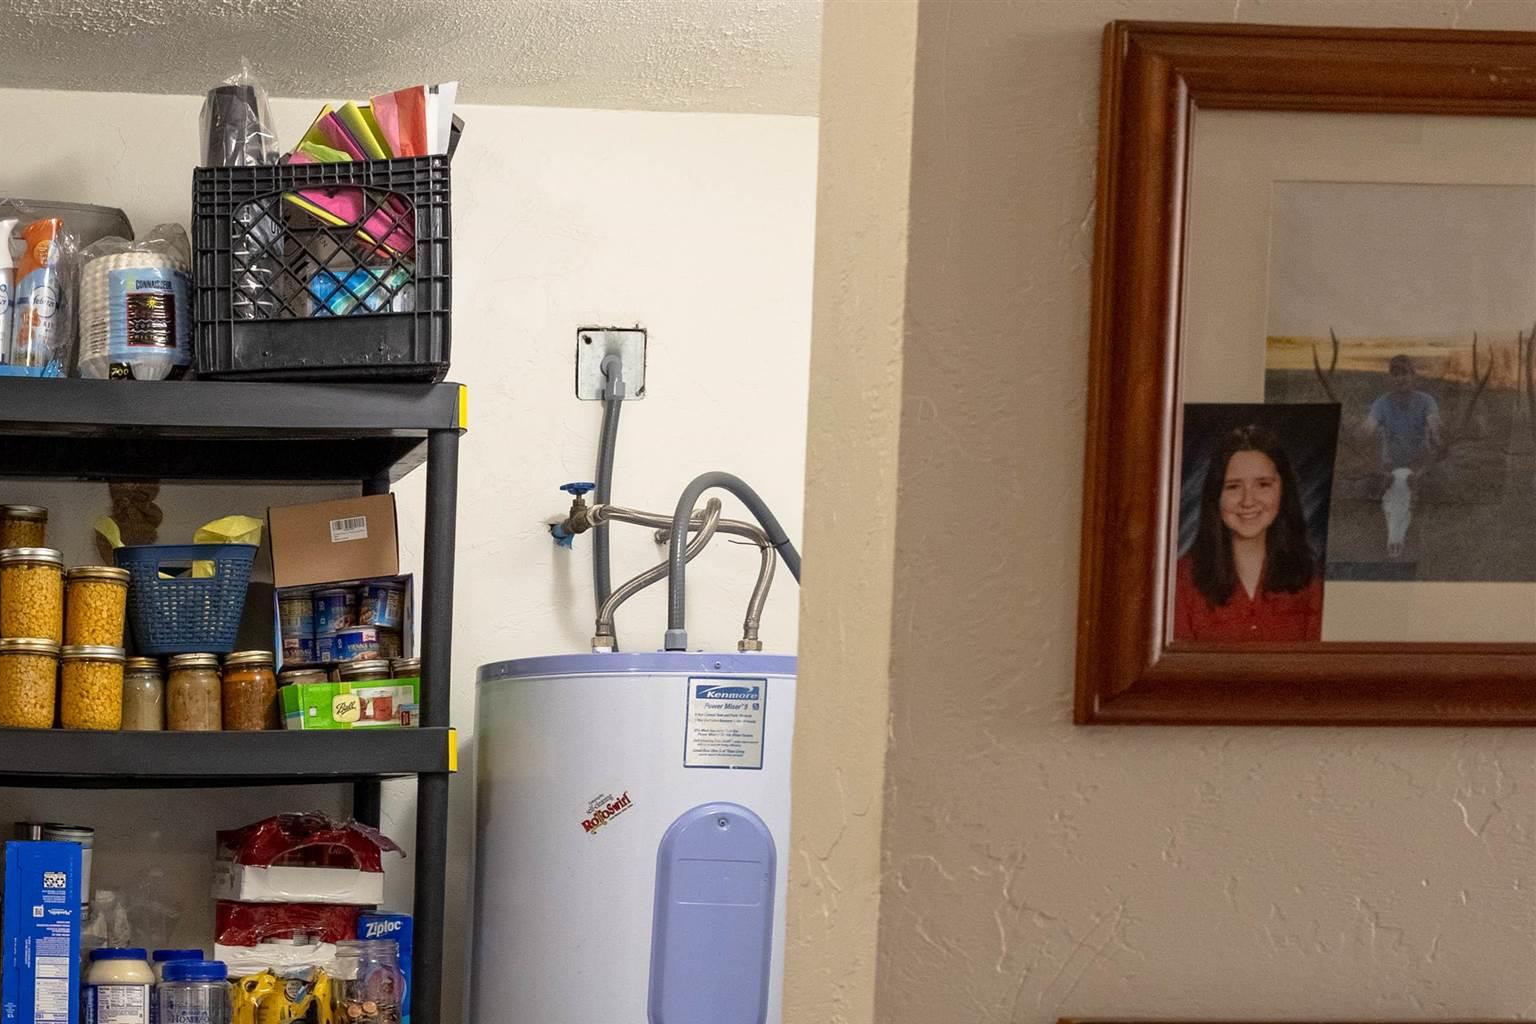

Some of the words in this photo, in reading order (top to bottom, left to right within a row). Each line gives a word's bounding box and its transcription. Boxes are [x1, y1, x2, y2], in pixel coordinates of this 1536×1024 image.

[706, 690, 758, 699] Kenmore
[336, 700, 357, 717] Ball
[365, 920, 404, 938] Ziploc
